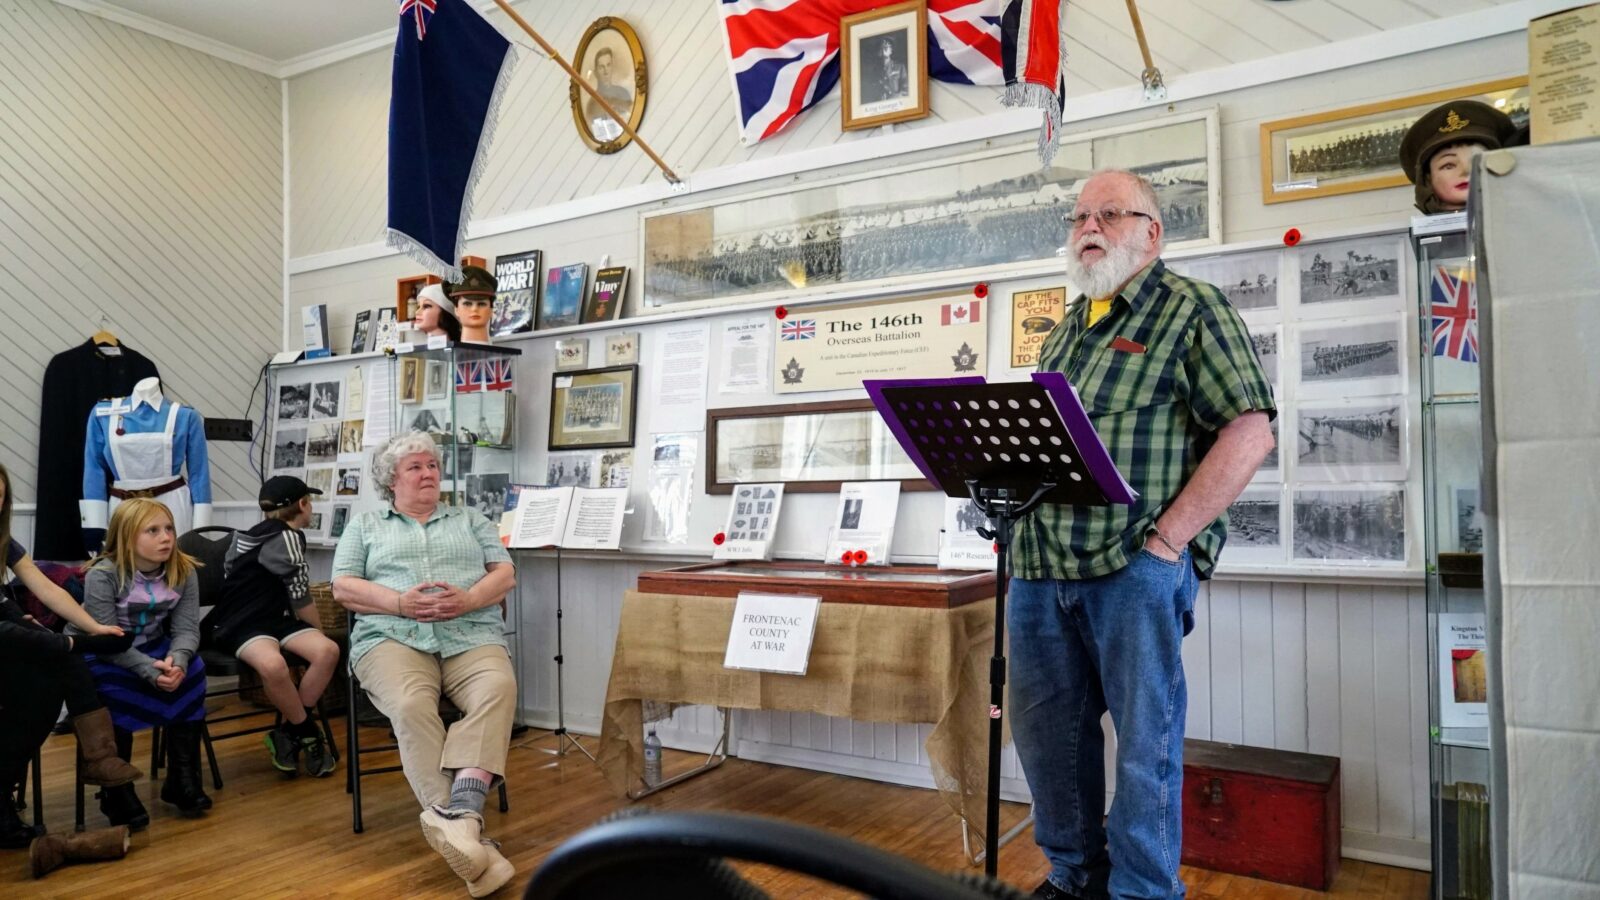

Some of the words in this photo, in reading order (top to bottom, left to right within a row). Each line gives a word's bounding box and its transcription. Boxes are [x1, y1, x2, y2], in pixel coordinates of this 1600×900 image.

[496, 259, 536, 277] WORLD
[496, 272, 529, 292] WAR
[528, 272, 534, 288] I
[1035, 291, 1052, 299] THE
[1017, 300, 1036, 309] CAP
[1039, 297, 1060, 306] FITS
[1025, 306, 1052, 314] YOU
[826, 320, 863, 334] The
[871, 313, 923, 330] 146th
[827, 335, 872, 346] Overseas
[875, 330, 921, 342] Battalion
[1018, 345, 1033, 353] THE
[966, 552, 995, 560] Research
[743, 614, 801, 627] FRONTENAC
[749, 627, 790, 639] COUNTY
[750, 640, 764, 651] AT
[764, 641, 785, 652] WAR
